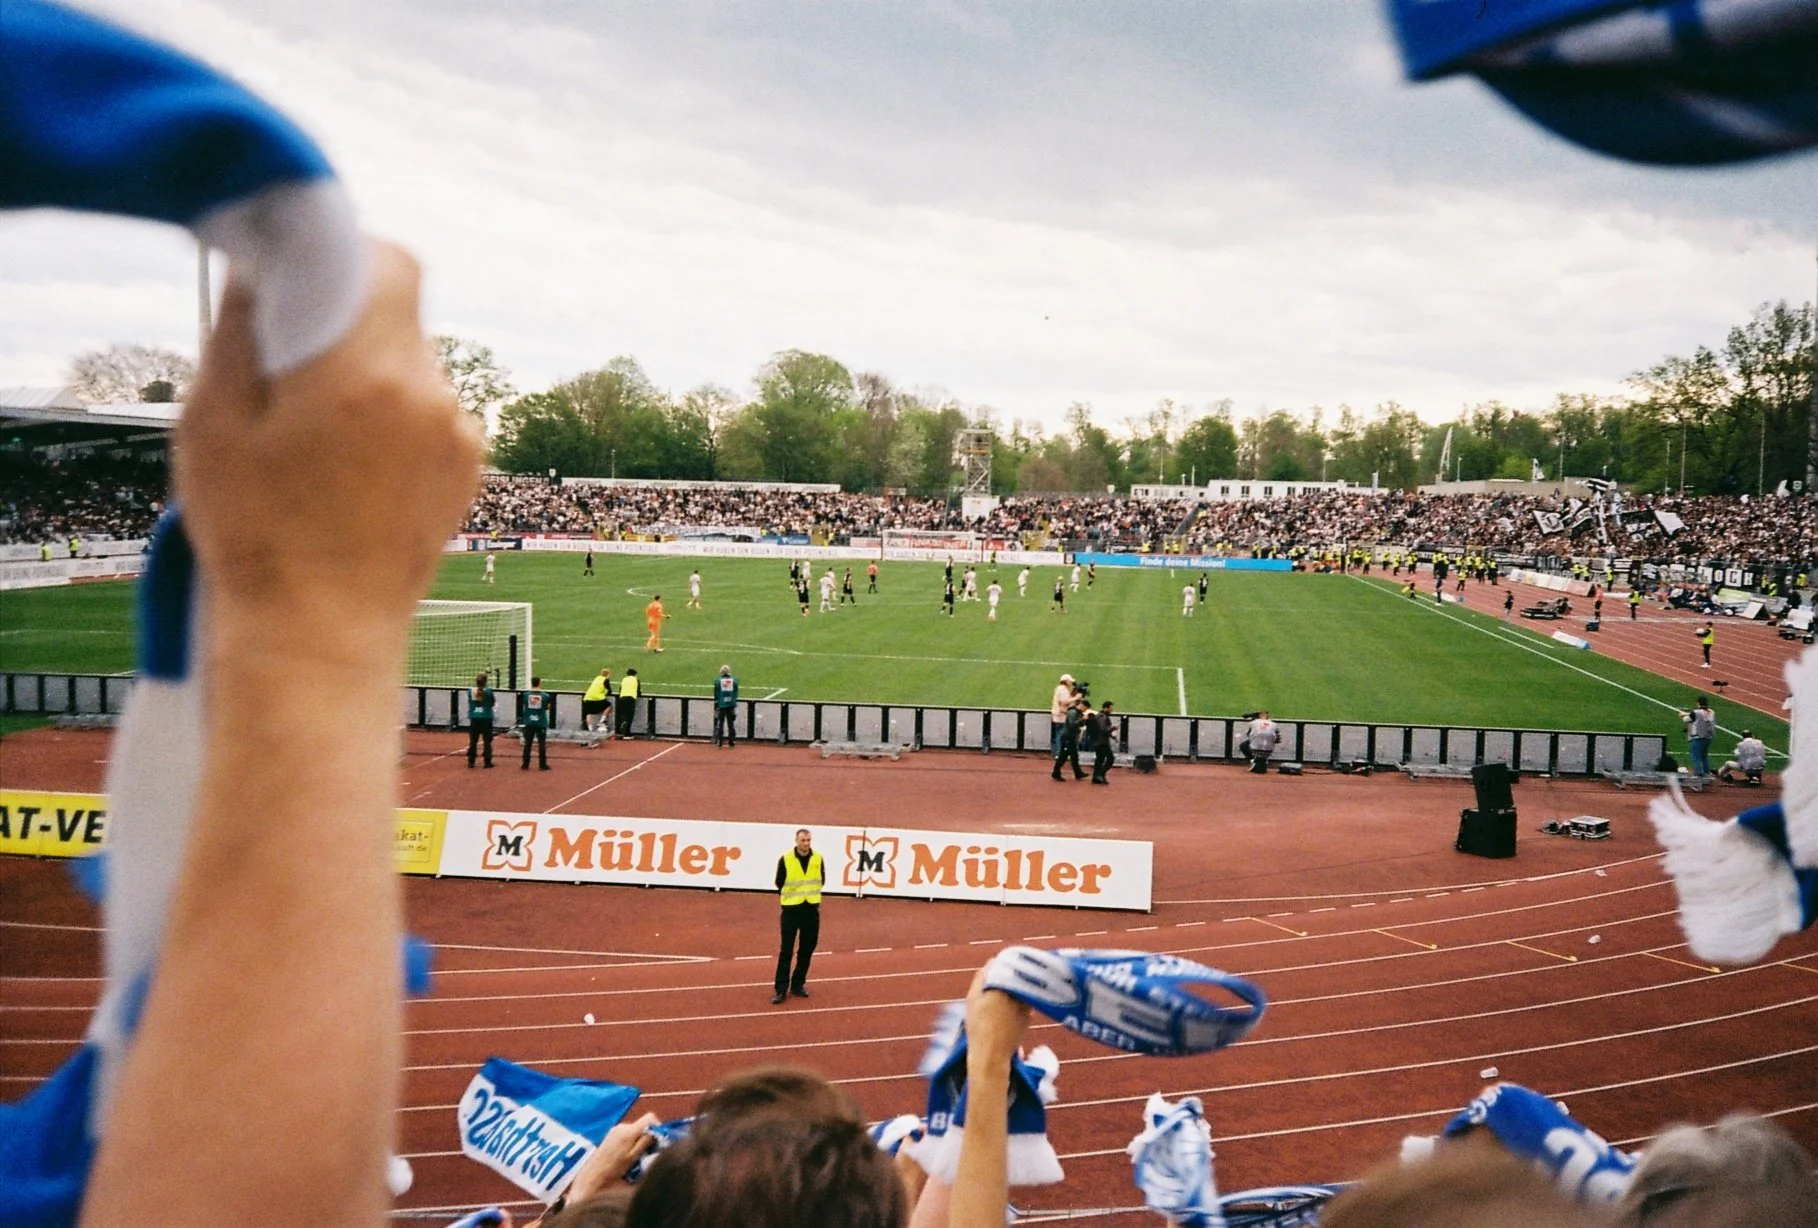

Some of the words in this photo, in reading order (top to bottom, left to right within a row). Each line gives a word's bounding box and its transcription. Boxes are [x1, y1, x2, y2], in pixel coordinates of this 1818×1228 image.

[1140, 556, 1162, 565] Finde
[1165, 557, 1188, 566] deine
[1190, 558, 1226, 567] Mission!
[495, 834, 524, 857] M
[544, 827, 742, 876] Müller
[856, 850, 885, 873] M
[908, 843, 1112, 894] Müller
